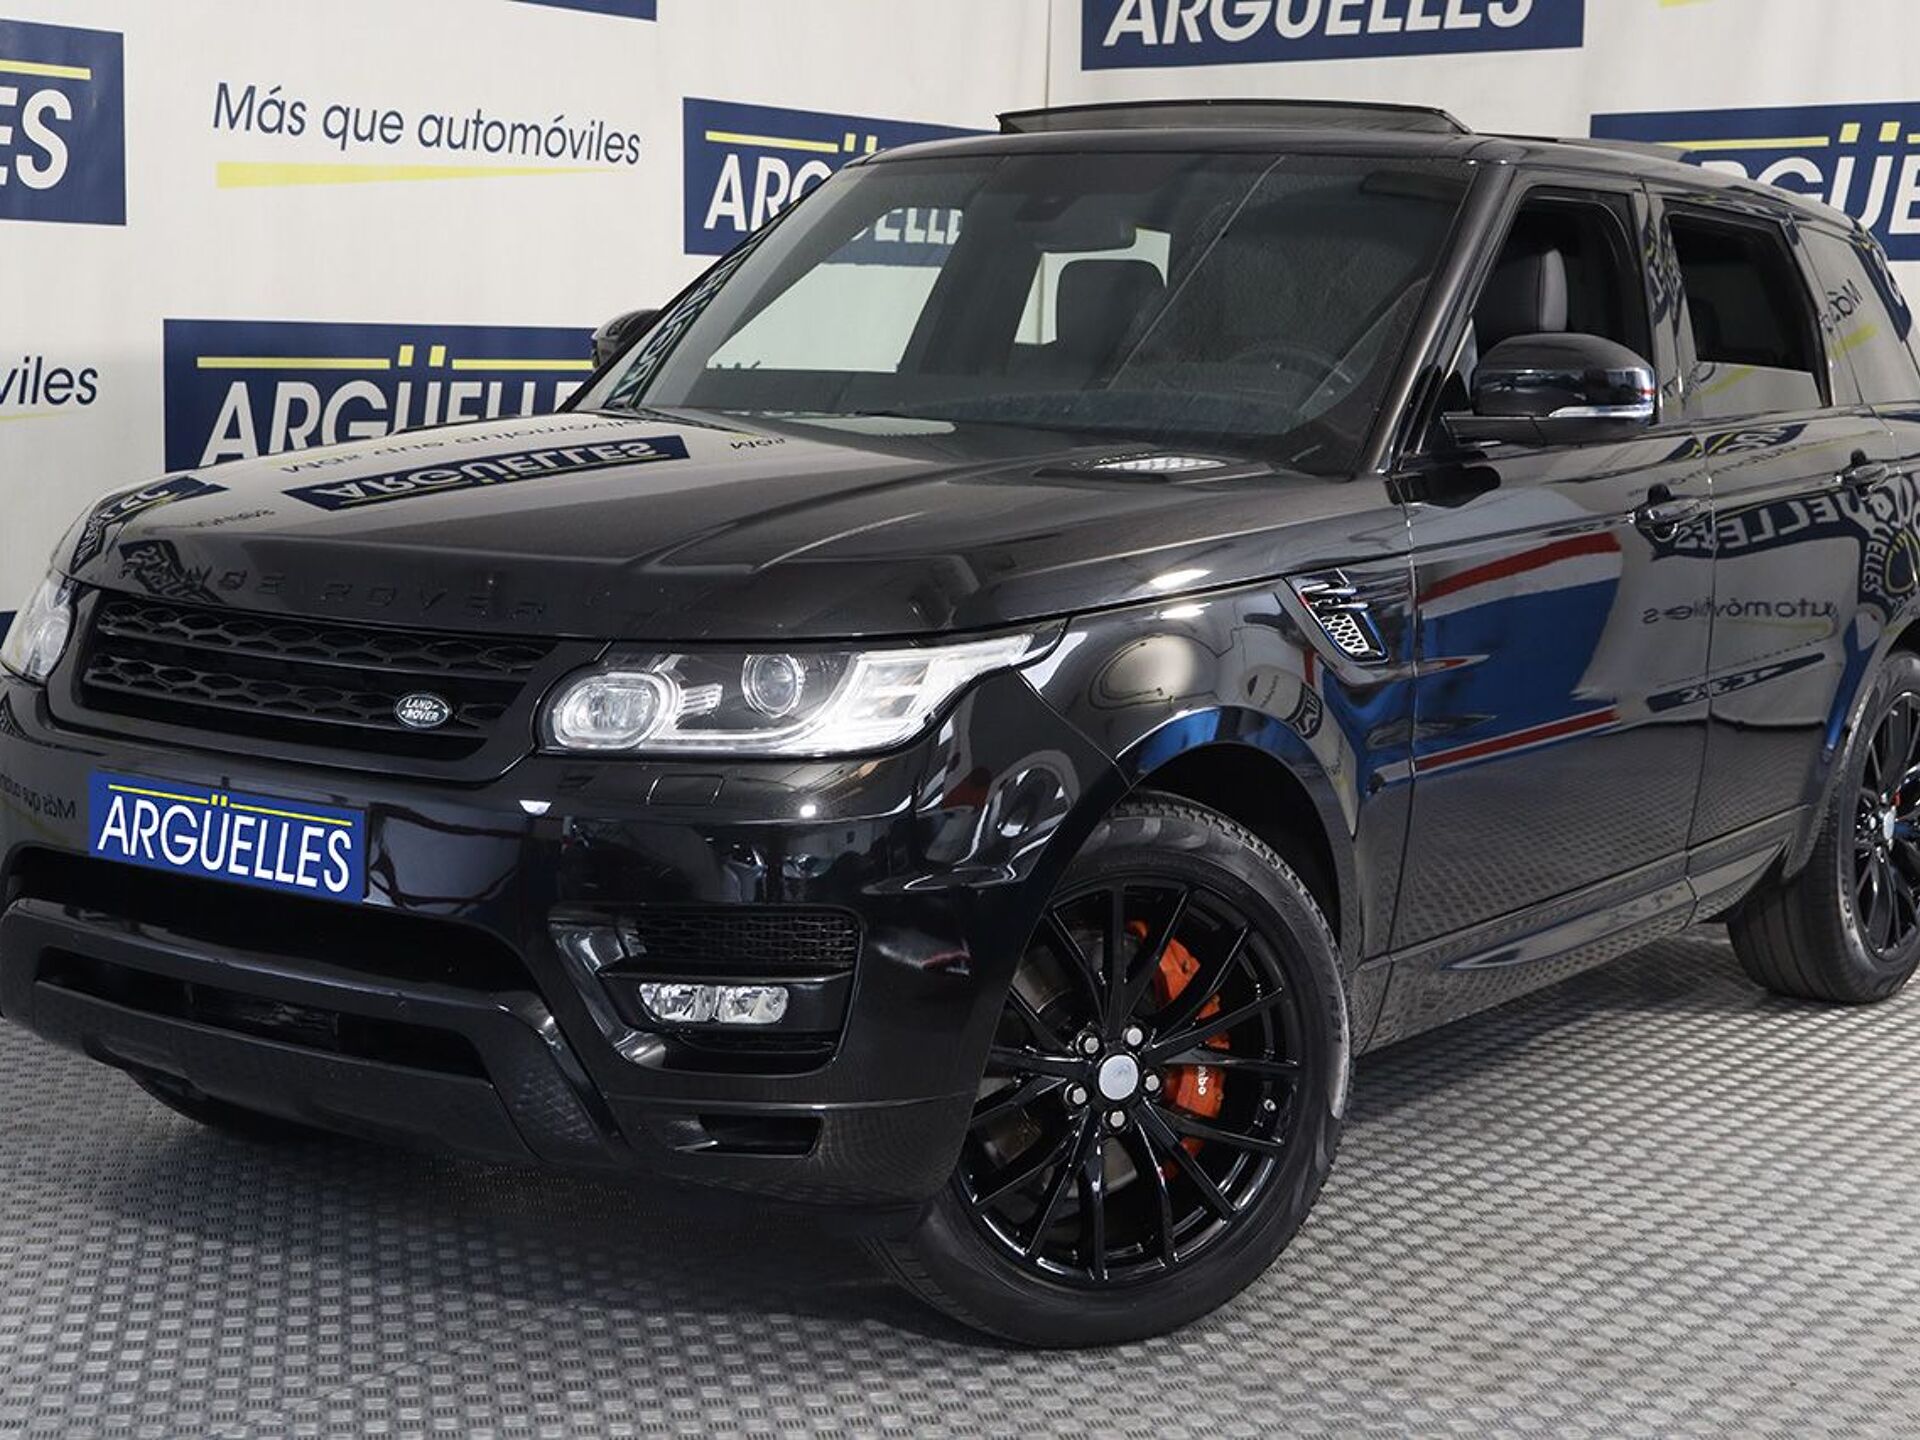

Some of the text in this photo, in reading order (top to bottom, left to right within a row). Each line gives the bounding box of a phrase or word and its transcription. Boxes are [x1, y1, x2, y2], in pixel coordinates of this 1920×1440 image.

[212, 81, 641, 165] Más que automóviles
[97, 794, 352, 893] ARGÜELLES
